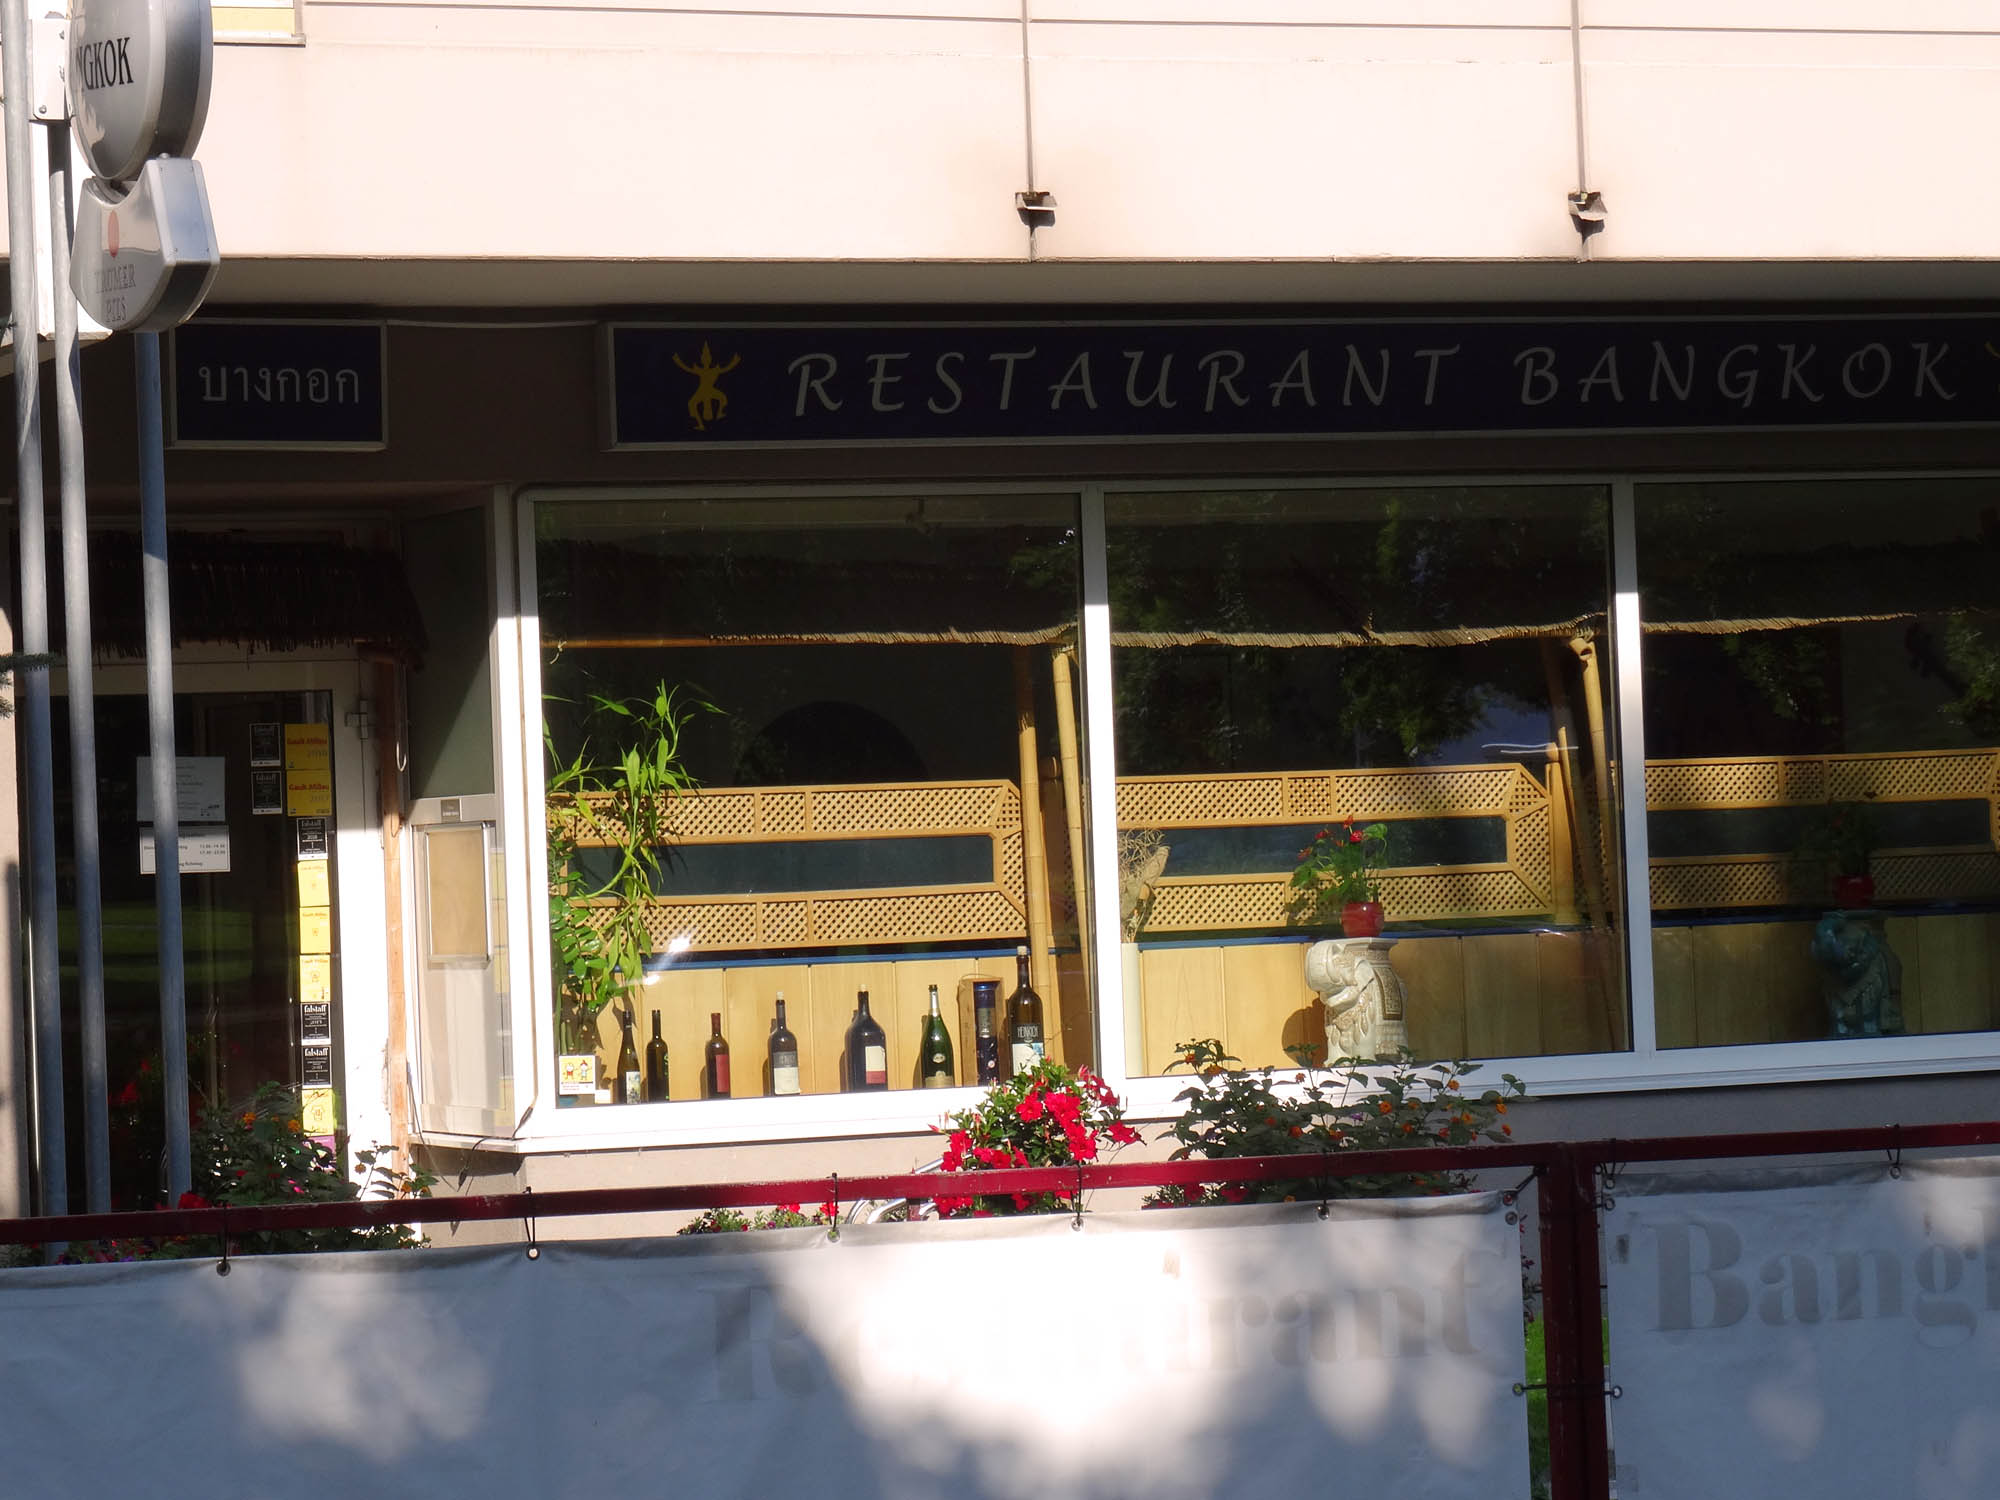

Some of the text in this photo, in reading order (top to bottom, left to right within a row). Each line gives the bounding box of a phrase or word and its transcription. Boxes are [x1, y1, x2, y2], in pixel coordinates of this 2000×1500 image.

[105, 296, 127, 323] PILS
[198, 366, 359, 404] บางกอก
[788, 340, 1958, 417] RESTAURANT BANGKOK
[304, 1005, 327, 1013] falstaff
[304, 1048, 329, 1057] falstaff
